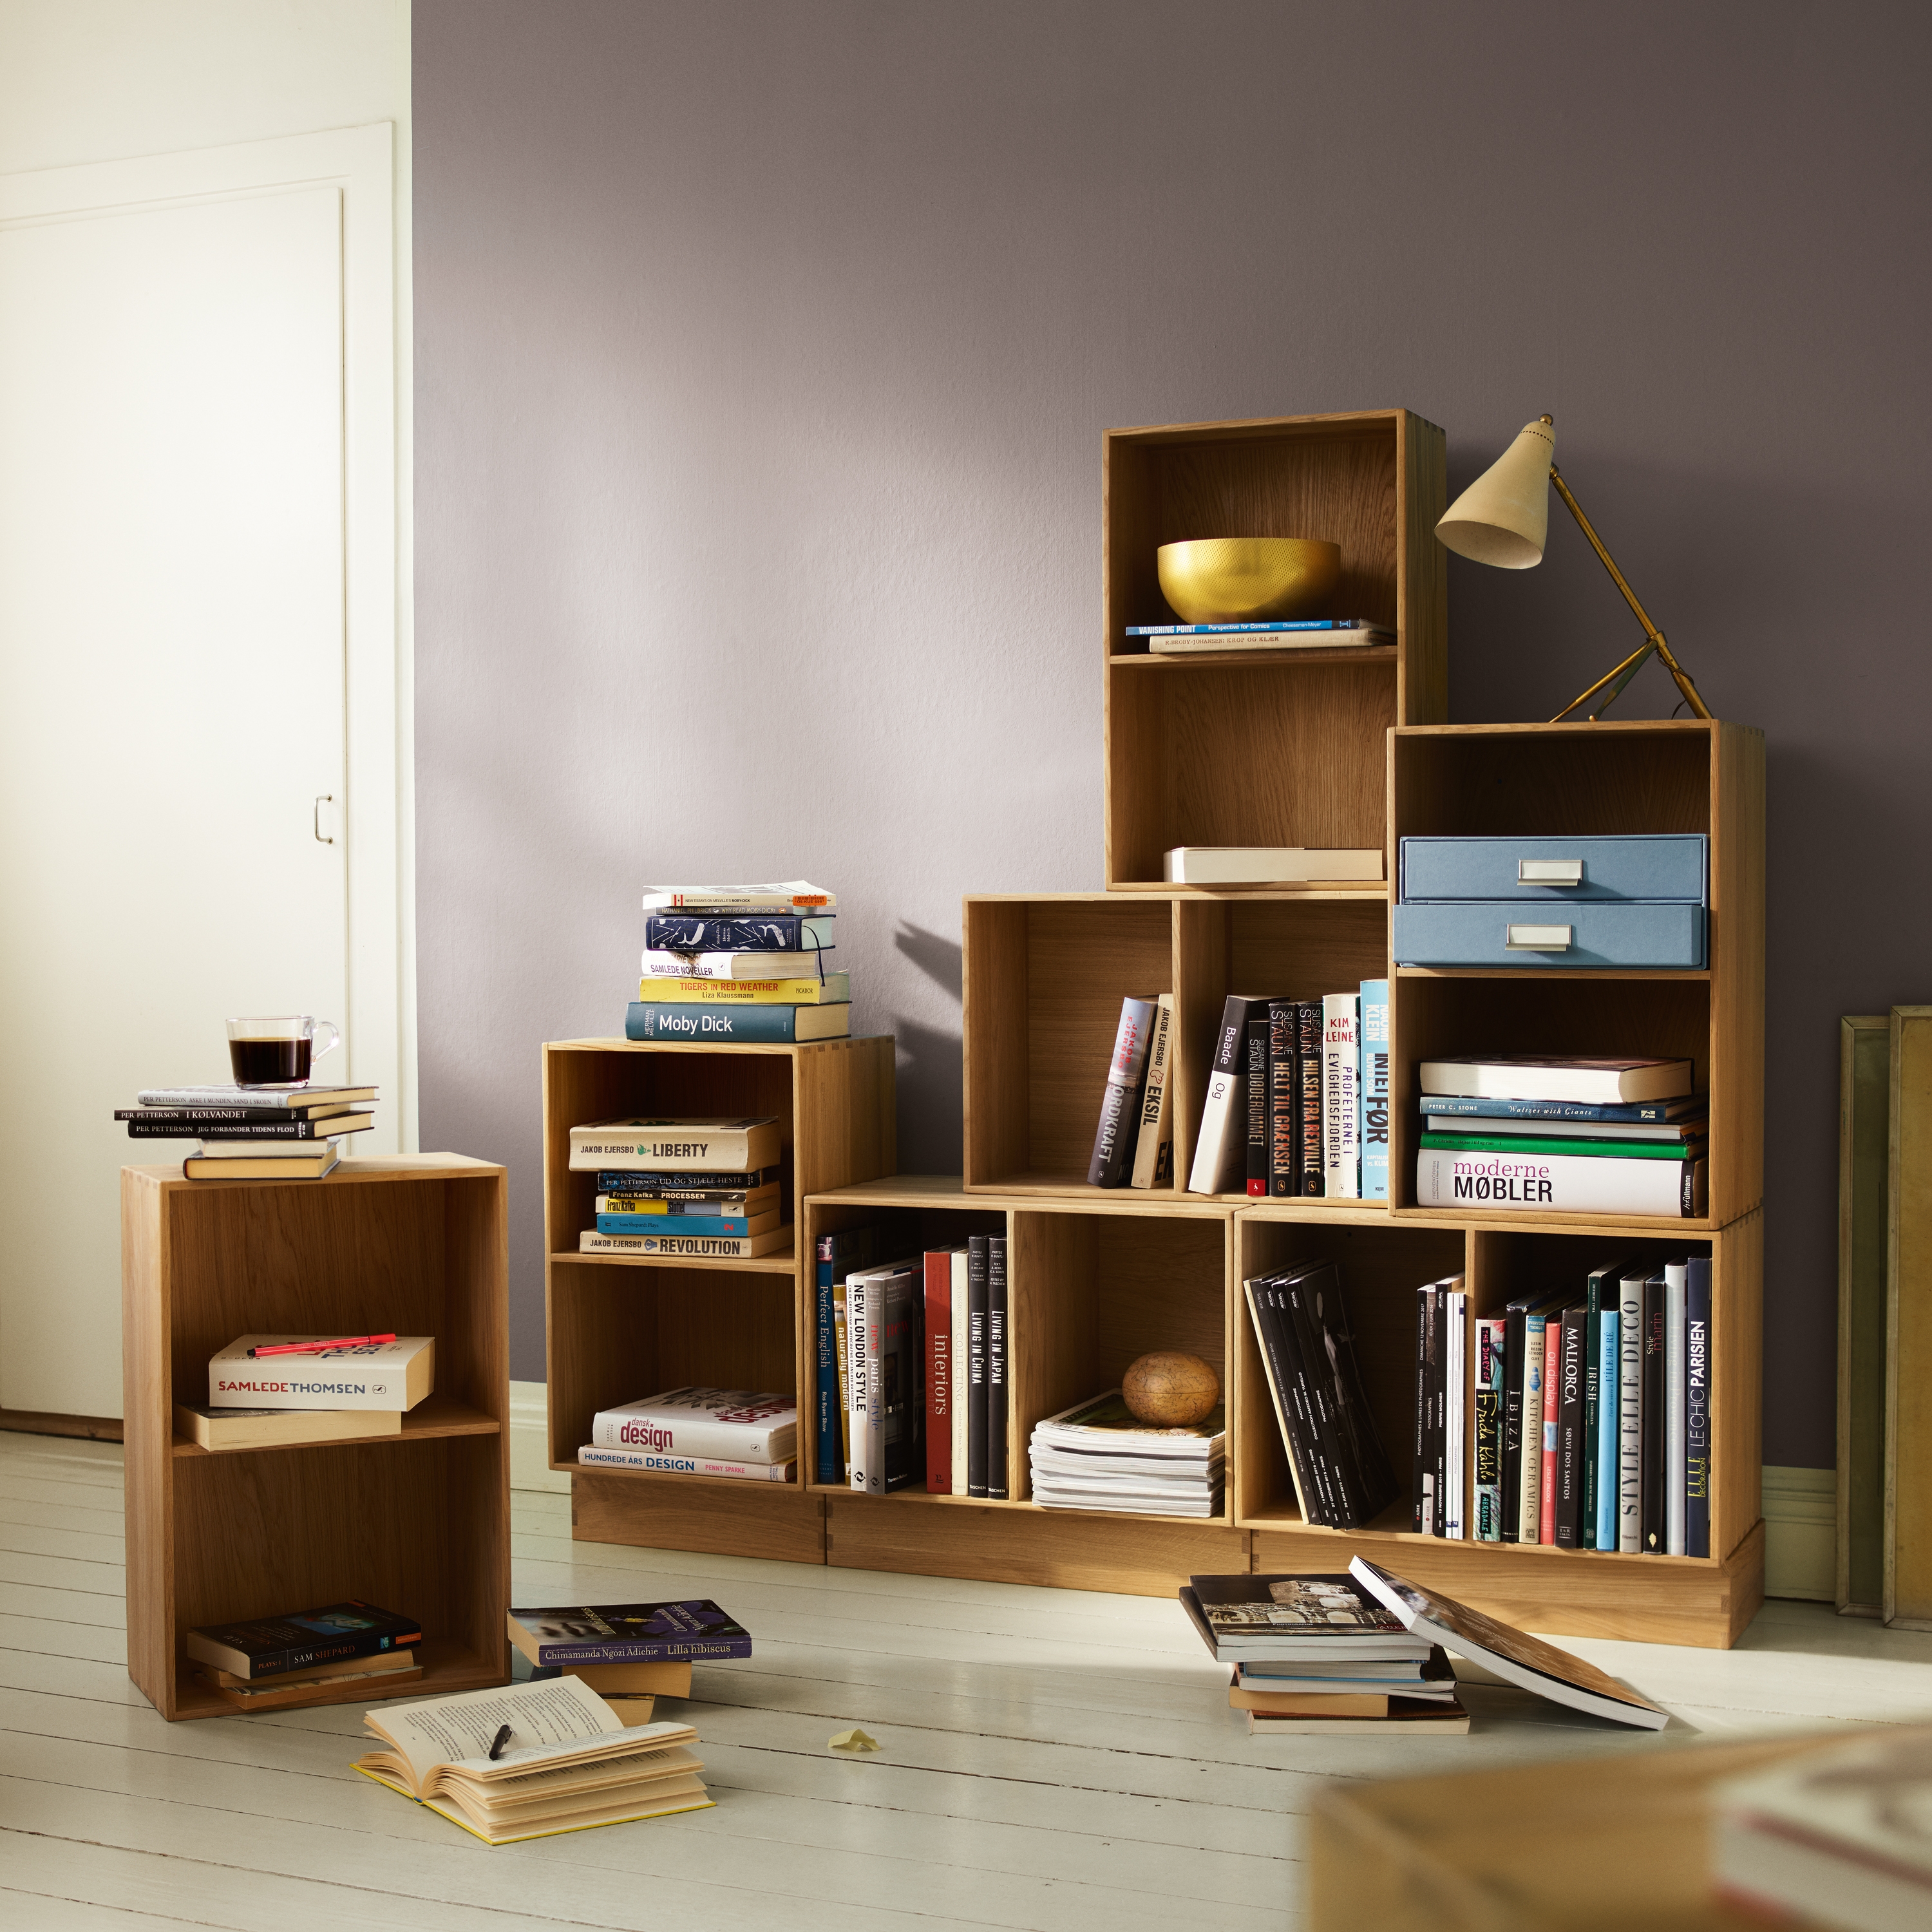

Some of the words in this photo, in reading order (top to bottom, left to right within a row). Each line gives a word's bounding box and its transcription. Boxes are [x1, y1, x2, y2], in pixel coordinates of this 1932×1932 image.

[1139, 625, 1174, 634] VANISHING
[1176, 625, 1196, 634] POINT
[650, 964, 680, 974] SAMLEDE
[681, 966, 714, 976] NOVELLER
[739, 983, 778, 991] WEATHER
[659, 1015, 698, 1035] Moby
[702, 1016, 733, 1032] Dick
[1160, 1007, 1170, 1032] JAKOB
[1271, 1010, 1283, 1055] STAUN
[1284, 1011, 1293, 1055] SUSANNE
[1300, 1009, 1311, 1054] STAUN
[1312, 1009, 1321, 1054] SUSANNE
[1326, 1032, 1354, 1042] LEINE
[1331, 1018, 1349, 1028] KIM
[1365, 1005, 1379, 1041] KLEIN
[1118, 1016, 1132, 1068] EJERSBO
[1125, 1024, 1137, 1064] JAKOB
[1155, 1033, 1167, 1066] EJERSBO
[1220, 1027, 1236, 1065] Baade
[1249, 1039, 1258, 1070] STAUN
[1212, 1083, 1225, 1100] Og
[1274, 1063, 1289, 1090] HELT
[1303, 1060, 1319, 1098] HILSEN
[192, 1110, 247, 1119] KØLVANDET
[1099, 1074, 1127, 1163] NORDKRAFT
[1142, 1084, 1162, 1126] EKSIL
[1249, 1074, 1264, 1146] DØDERUMMET
[1274, 1094, 1289, 1112] TIL
[1303, 1101, 1319, 1121] FRA
[1329, 1054, 1340, 1167] EVIGHEDSFJORDEN
[1342, 1066, 1352, 1146] PROFETERNE
[581, 1145, 603, 1154] JAKOB
[604, 1145, 634, 1154] EJERSBO
[653, 1144, 708, 1158] LIBERTY
[1274, 1115, 1290, 1173] GRÆNSEN
[1303, 1124, 1320, 1173] REXVILLE
[1454, 1159, 1549, 1179] moderne
[607, 1200, 621, 1211] Franz
[621, 1200, 636, 1212] Kafka
[668, 1202, 685, 1213] Slottet
[1454, 1176, 1553, 1203] MØBLER
[590, 1239, 612, 1247] JAKOB
[613, 1240, 641, 1248] EJERSBO
[659, 1239, 741, 1255] REVOLUTION
[820, 1286, 830, 1323] Perfect
[854, 1285, 864, 1314] NEW
[855, 1318, 866, 1368] LONDON
[972, 1312, 984, 1341] LIVING
[992, 1311, 1005, 1340] LIVING
[1622, 1300, 1640, 1364] DECO
[1651, 1312, 1662, 1351] marin
[819, 1327, 830, 1367] English
[838, 1327, 848, 1370] naturally
[972, 1345, 981, 1354] IN
[992, 1343, 1001, 1352] IN
[1548, 1352, 1556, 1365] on
[1690, 1321, 1705, 1387] PARISIEN
[867, 1358, 882, 1393] paris
[935, 1334, 948, 1415] interiors
[972, 1358, 984, 1384] CHINA
[992, 1356, 1005, 1383] JAPAN
[1565, 1327, 1579, 1405] MALLORCA
[841, 1374, 850, 1410] modern
[856, 1372, 866, 1412] STYLE
[1544, 1369, 1558, 1406] display
[632, 1417, 649, 1427] dansk
[868, 1399, 884, 1430] style
[1476, 1392, 1498, 1440] Frida
[1509, 1390, 1520, 1451] IBIZA
[1622, 1376, 1639, 1435] ELLE
[1690, 1390, 1705, 1428] CHIC
[621, 1421, 673, 1452] design
[1529, 1399, 1538, 1452] KITCHEN
[1690, 1431, 1704, 1446] LE
[585, 1453, 627, 1463] HUNDREDE
[628, 1455, 643, 1464] ÅRS
[647, 1457, 695, 1471] DESIGN
[1479, 1446, 1495, 1481] Kahlo
[1687, 1457, 1701, 1497] ELLE
[1526, 1458, 1537, 1519] CERAMICS
[1622, 1444, 1638, 1516] STYLE
[258, 1660, 277, 1669] PLAYS:
[294, 1653, 313, 1663] SAM
[316, 1645, 355, 1660] SHEPARD
[546, 1651, 600, 1660] Chimamanda
[603, 1650, 625, 1660] Ngozi
[627, 1647, 658, 1656] Adichie
[667, 1645, 688, 1655] Lilla
[690, 1643, 731, 1654] hibiscus
